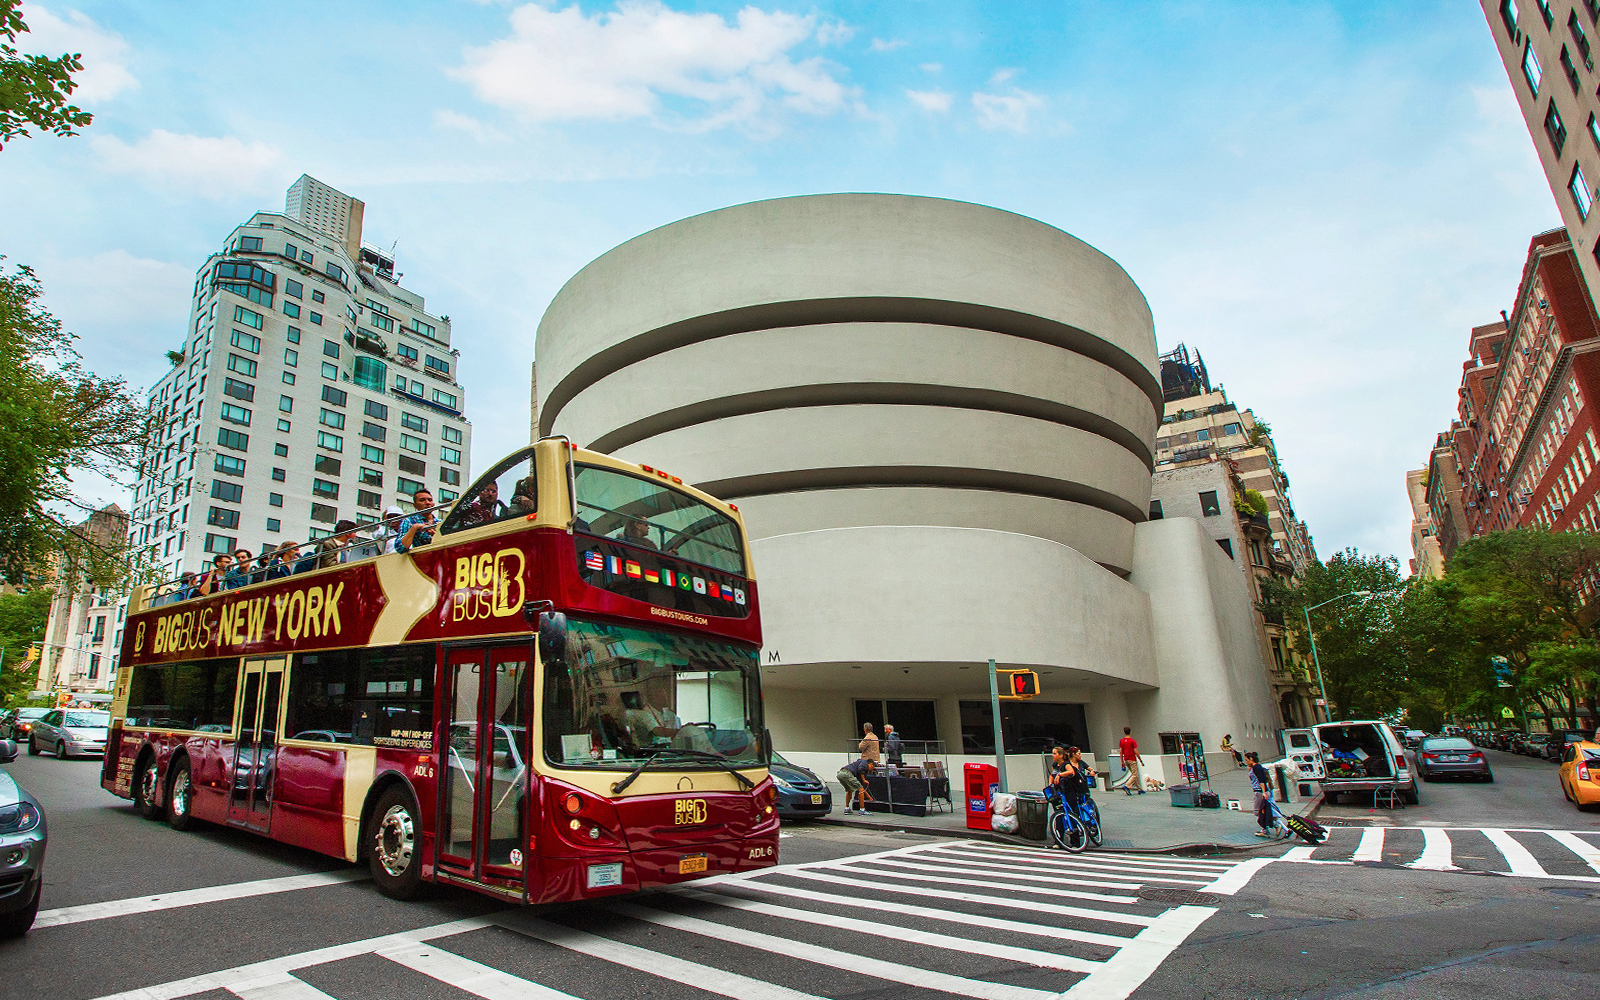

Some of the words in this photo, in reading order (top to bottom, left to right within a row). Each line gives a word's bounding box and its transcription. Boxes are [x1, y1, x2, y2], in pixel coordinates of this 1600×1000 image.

[454, 552, 493, 590] BIG
[453, 588, 491, 622] BUS
[217, 595, 270, 647] NEW
[275, 581, 345, 641] YORK
[650, 606, 709, 626] BIGBUSTOURS.COM
[768, 650, 780, 663] M
[413, 765, 428, 777] ADL
[428, 767, 434, 778] 6
[675, 799, 694, 813] BIG
[675, 812, 694, 825] BUS
[748, 847, 766, 859] ADL
[766, 845, 773, 856] 6
